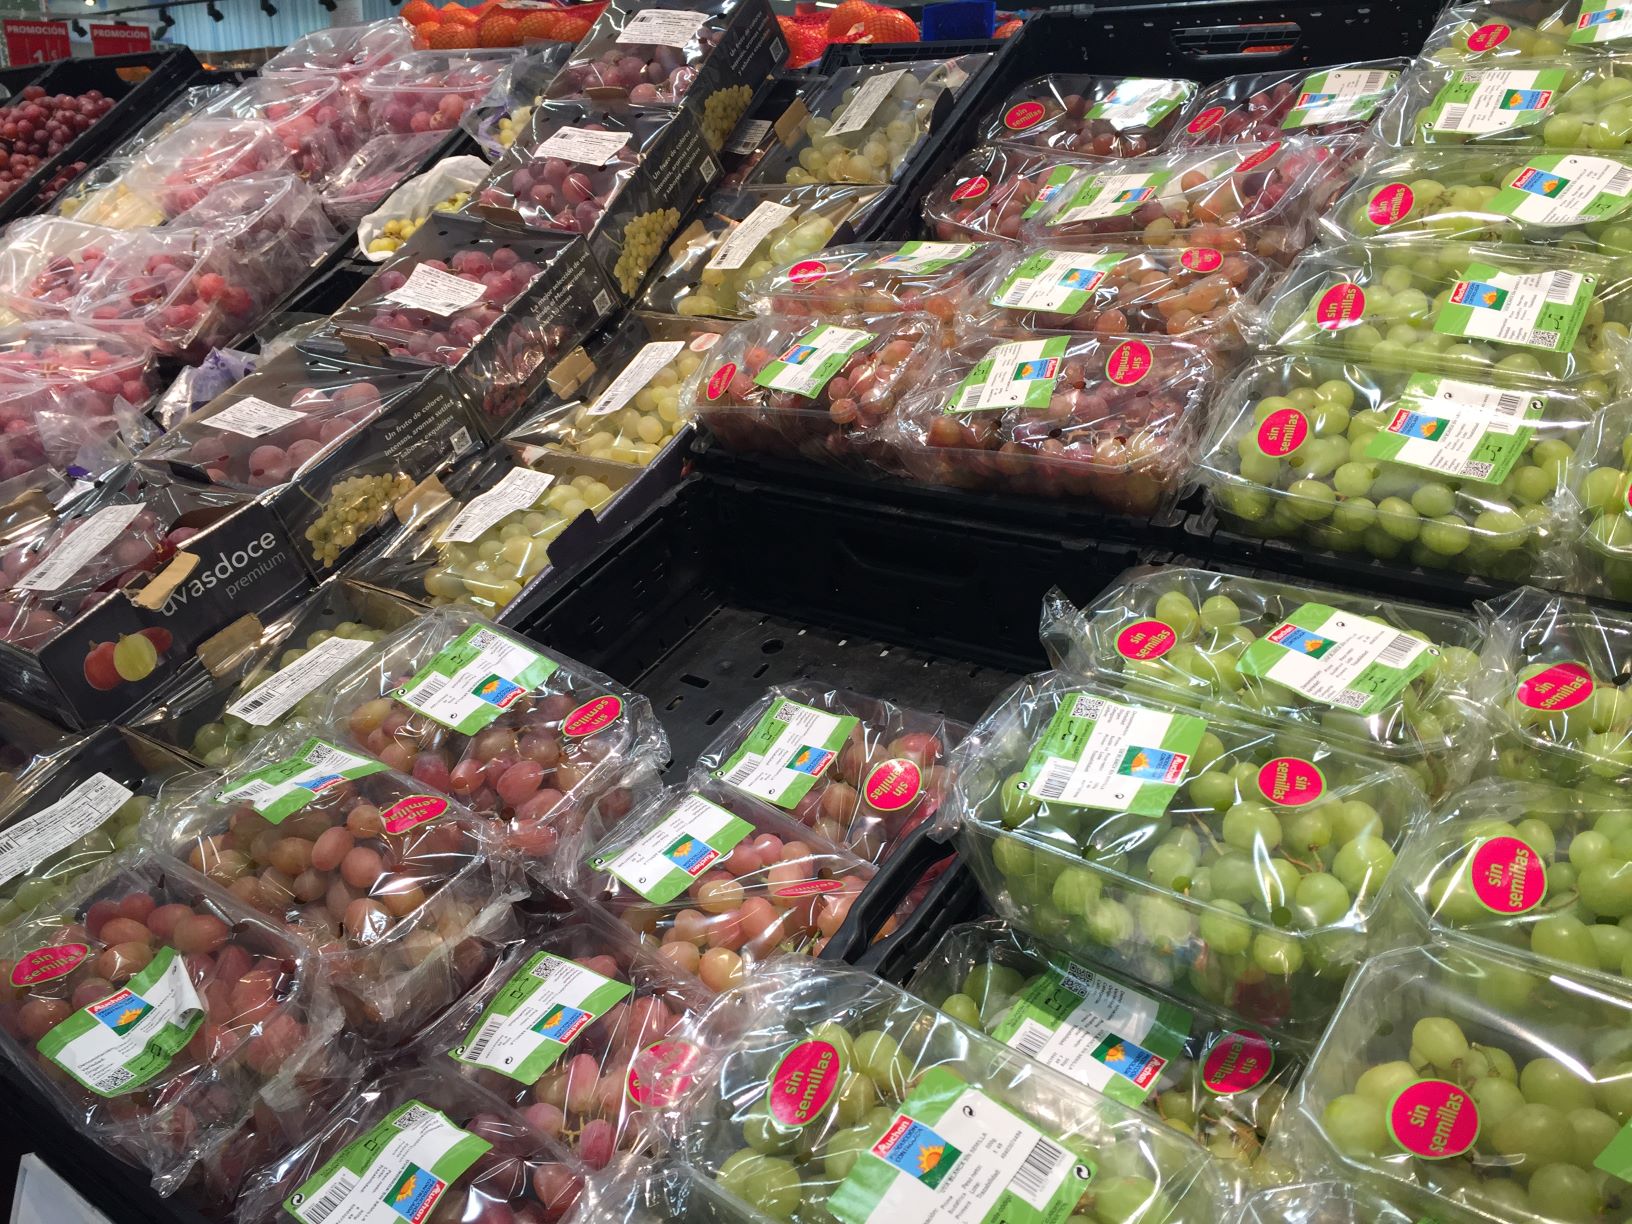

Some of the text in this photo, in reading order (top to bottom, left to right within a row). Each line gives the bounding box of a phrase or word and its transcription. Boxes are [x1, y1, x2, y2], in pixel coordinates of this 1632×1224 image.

[7, 25, 66, 35] PROMOCIÓN
[93, 29, 147, 38] PROMOCIÓN
[1012, 109, 1043, 128] semillas
[1015, 107, 1028, 117] sin
[1515, 168, 1536, 188] Auchan
[1378, 200, 1388, 215] sin
[1389, 187, 1405, 221] semillas
[530, 303, 539, 314] La
[537, 287, 554, 307] mejor
[551, 267, 574, 290] selección
[1453, 282, 1469, 303] Auchan
[1325, 302, 1338, 319] sin
[1340, 287, 1357, 323] millas
[1115, 345, 1131, 380] semillas
[1131, 356, 1142, 370] sin
[384, 394, 444, 441] Un fruto de colores
[384, 399, 456, 457] intensos, aromas sutiles
[424, 415, 454, 440] exquisitos
[1391, 410, 1409, 432] Auchan
[1268, 425, 1279, 442] sin
[1280, 413, 1300, 452] semillas
[160, 532, 277, 617] uvasdoce
[225, 551, 286, 600] premium
[1129, 631, 1146, 645] sin
[1136, 629, 1172, 659] semillas
[1271, 627, 1296, 642] Auchan
[499, 688, 524, 707] Auchan
[1534, 680, 1555, 694] sin
[1539, 674, 1589, 709] semillas
[567, 698, 610, 731] semillas
[591, 713, 609, 726] sin
[812, 753, 835, 776] Auchan
[1164, 755, 1185, 783] Auchan
[893, 779, 909, 798] sin
[1273, 761, 1290, 801] semillas
[1295, 775, 1308, 791] sin
[407, 808, 428, 820] sin
[690, 852, 716, 873] Auchan
[1485, 862, 1504, 888] sin
[1508, 847, 1530, 909] semillas
[23, 950, 84, 982] semillas
[31, 952, 54, 966] sin
[94, 993, 129, 1012] Auchan
[562, 1015, 588, 1041] Auchan
[1135, 1056, 1164, 1086] Auchan
[1210, 1036, 1246, 1086] semillas
[1240, 1056, 1257, 1075] sin
[784, 1070, 805, 1095] sin
[795, 1051, 833, 1119] semillas
[1407, 1104, 1431, 1128] sin
[1428, 1092, 1464, 1153] semillas
[878, 1121, 909, 1155] Auchan
[414, 1183, 440, 1221] Auchan
